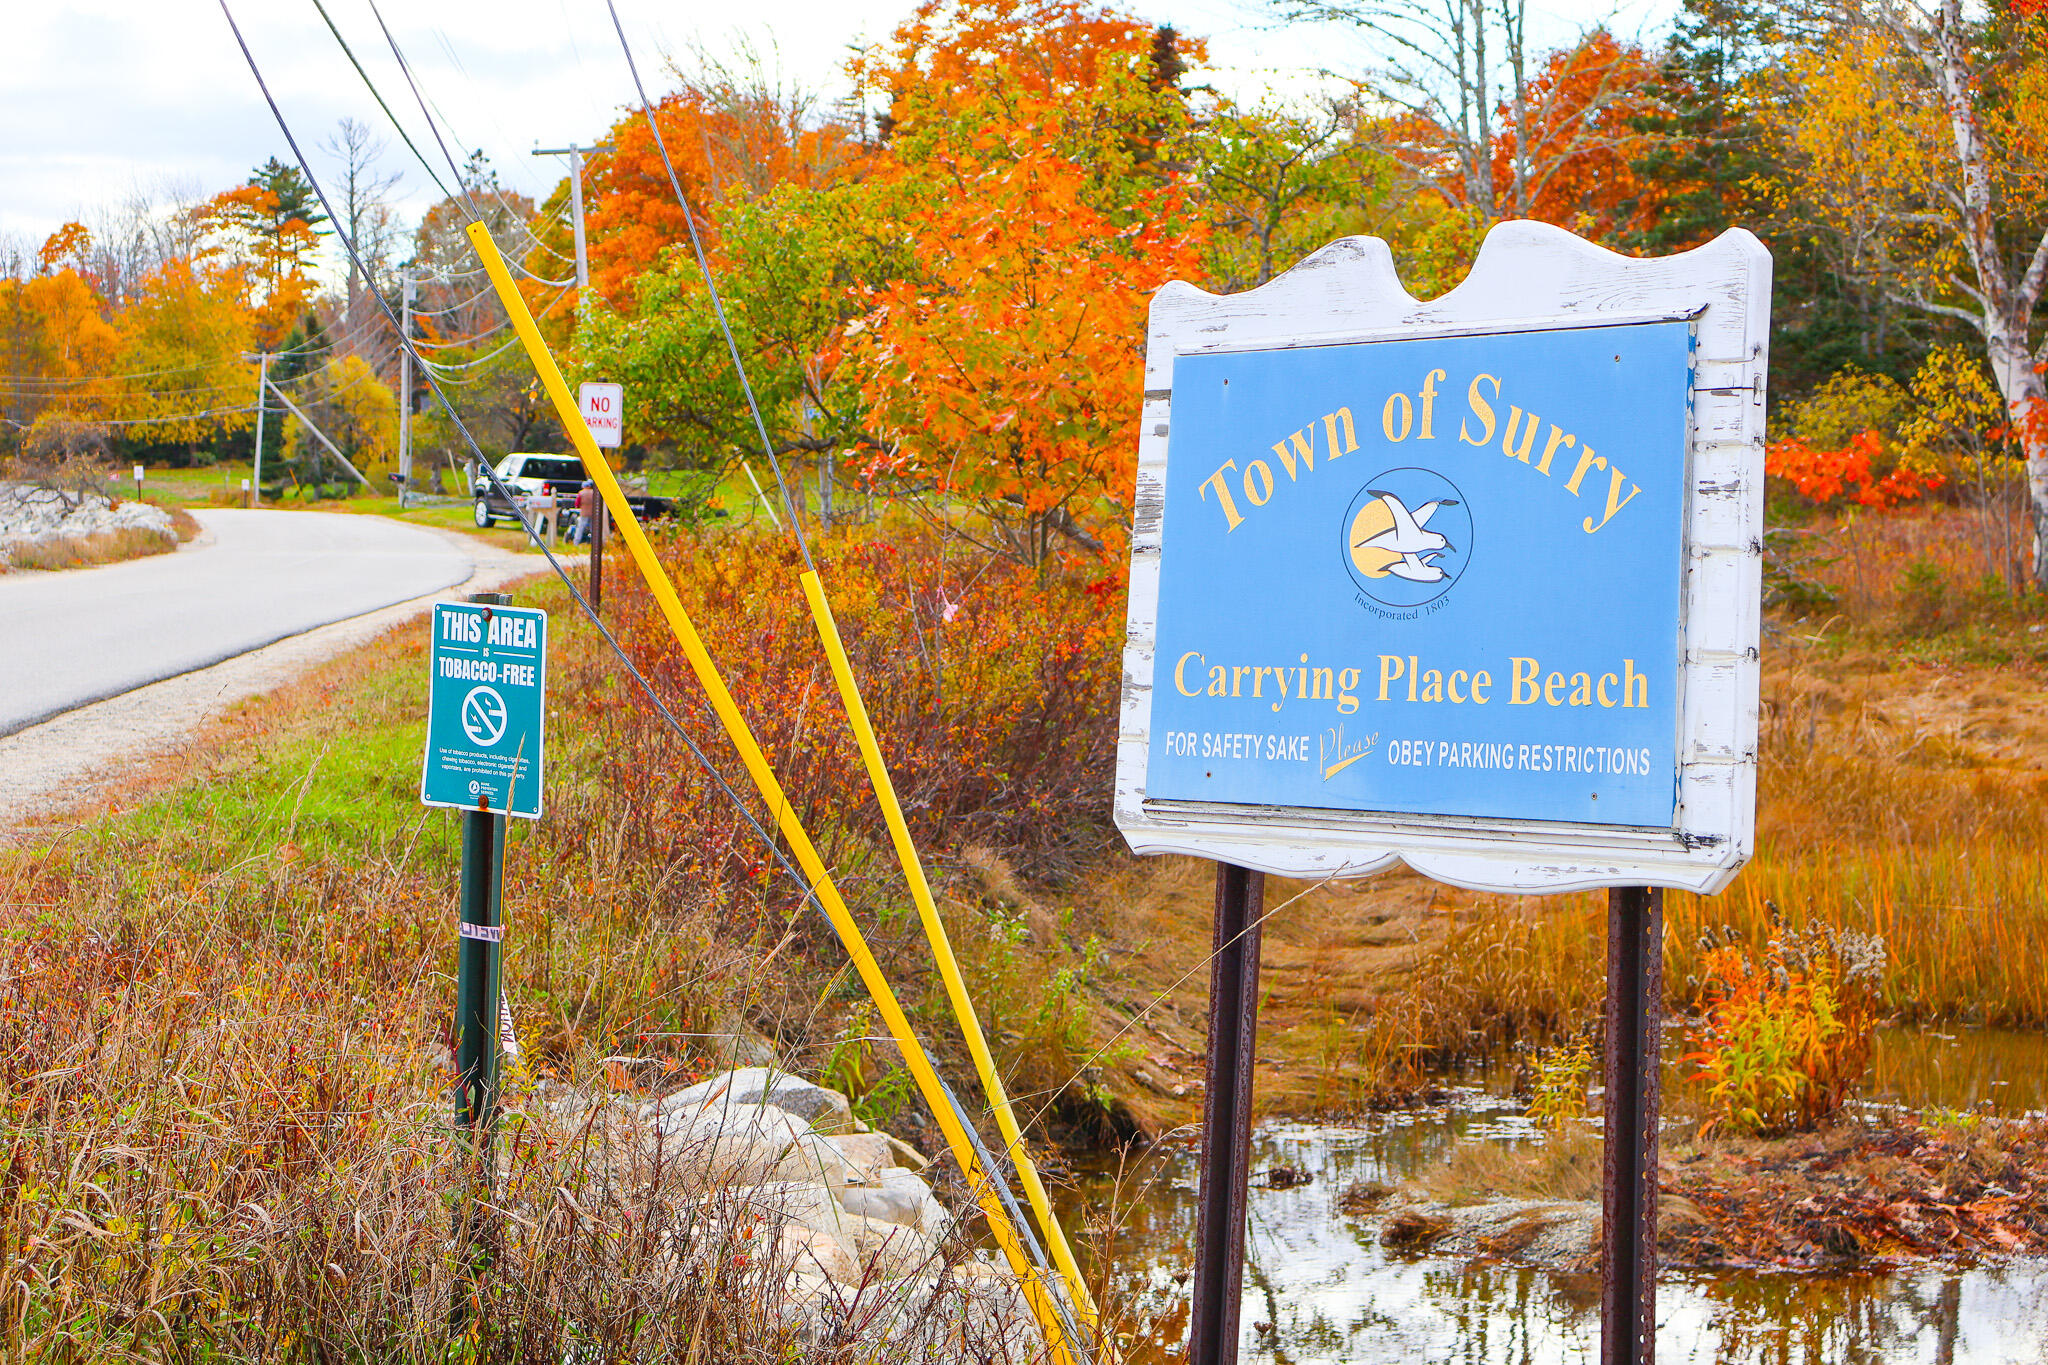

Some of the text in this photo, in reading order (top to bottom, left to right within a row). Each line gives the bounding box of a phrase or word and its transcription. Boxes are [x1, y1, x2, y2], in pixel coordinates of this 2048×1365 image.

[591, 396, 610, 412] NO
[1198, 368, 1642, 534] Town of Surry
[1354, 592, 1450, 621] Incorporated 1803
[441, 610, 537, 649] THIS AREA
[483, 647, 490, 658] IS
[438, 656, 535, 687] TOBACCO-FREE
[1174, 651, 1650, 715] Carrying Place Beach
[1166, 722, 1650, 777] FOR SAFETY SAKE Please OBEY PARKING RESTRICTIONS
